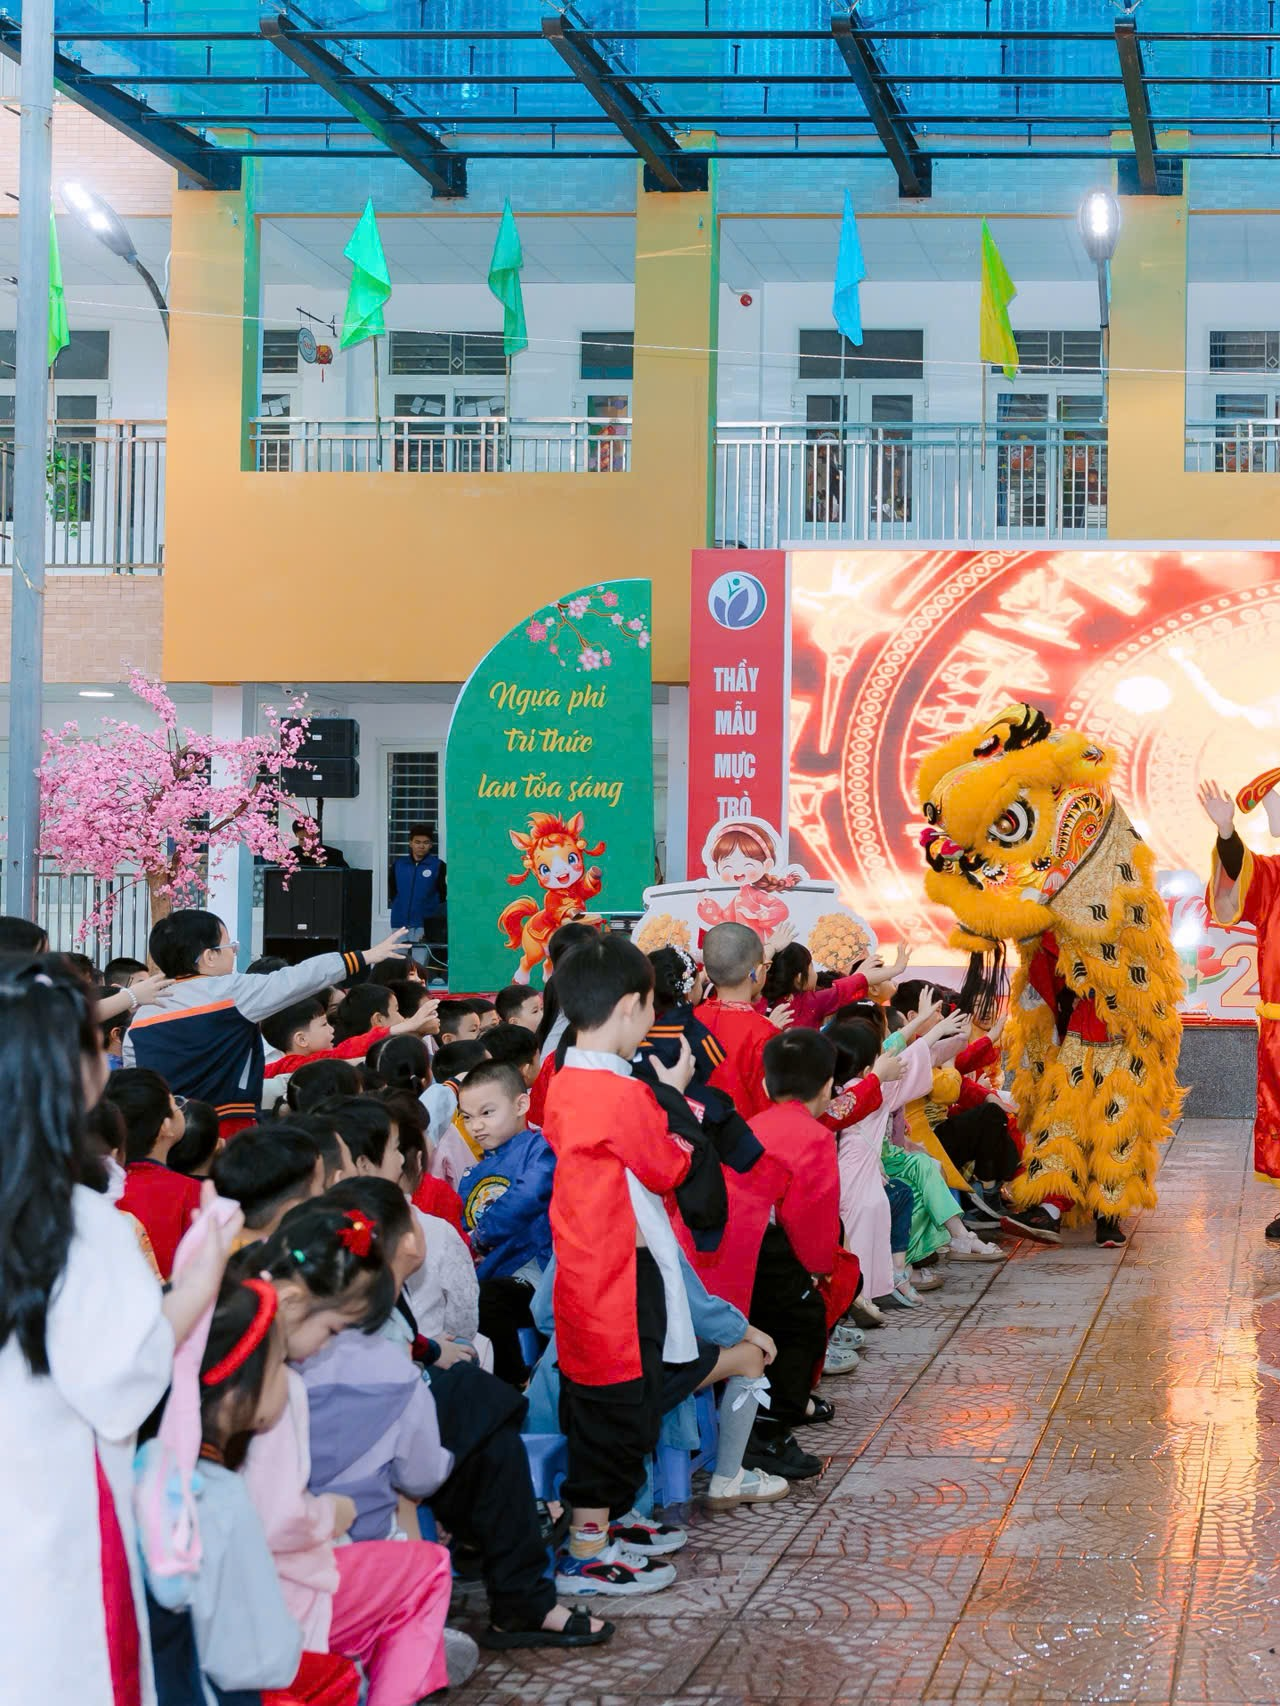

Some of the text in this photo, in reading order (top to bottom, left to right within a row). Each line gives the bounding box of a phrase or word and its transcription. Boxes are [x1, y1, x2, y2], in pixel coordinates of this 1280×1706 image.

[713, 658, 760, 693] THẦY
[489, 681, 606, 716] Ngựa phi
[715, 700, 757, 736] MẪU
[538, 728, 593, 753] thức
[714, 750, 756, 784] MỰC
[478, 771, 623, 807] lan tỏa sáng
[716, 790, 752, 819] TRÒ
